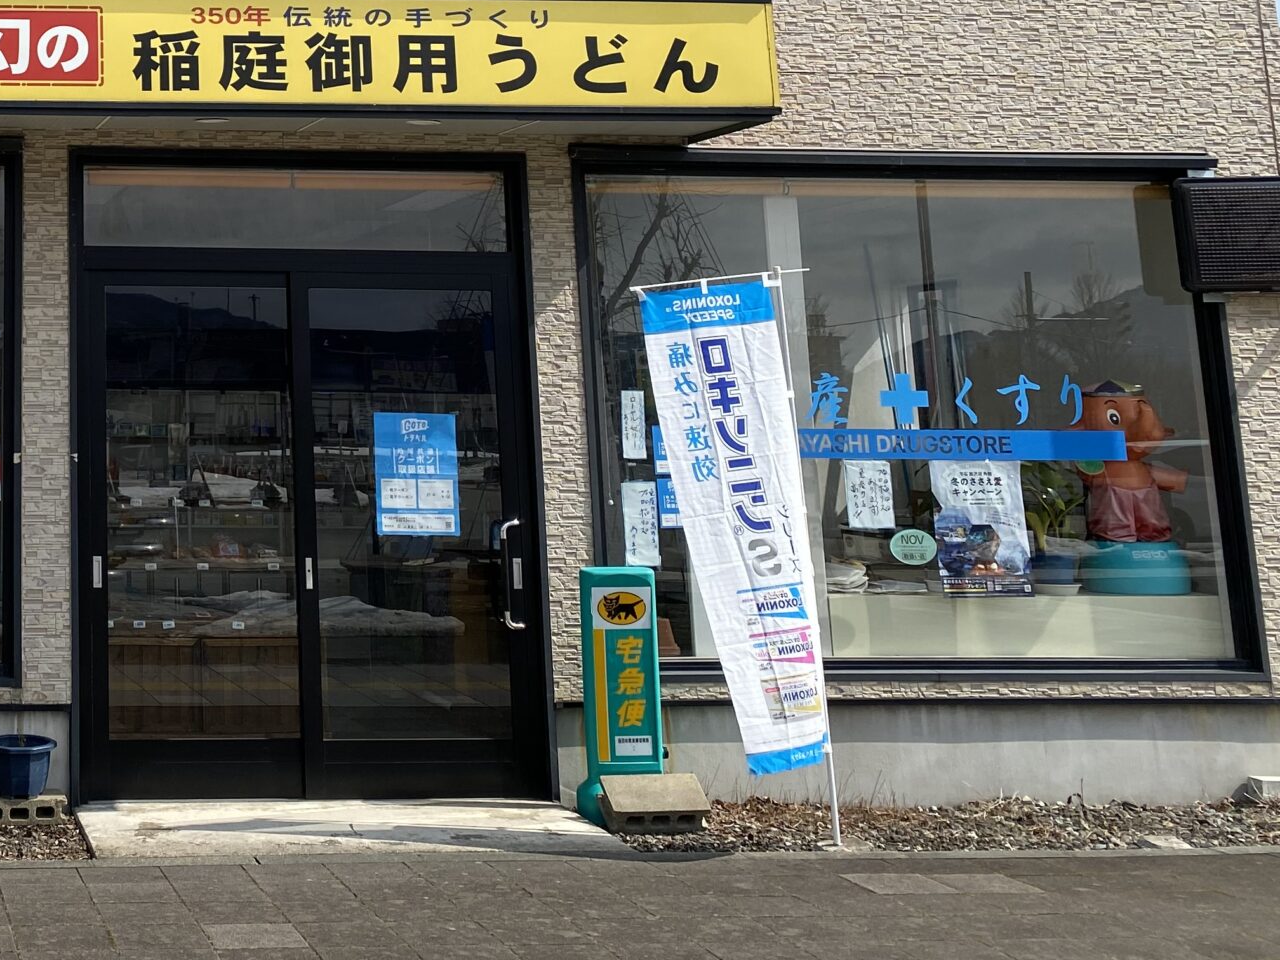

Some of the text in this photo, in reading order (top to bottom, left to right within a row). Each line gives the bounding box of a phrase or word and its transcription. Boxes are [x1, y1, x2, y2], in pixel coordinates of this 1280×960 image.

[132, 30, 719, 95] 稲庭御用うどん
[955, 373, 1084, 425] くすり
[877, 435, 1013, 455] DRUGSTORE
[398, 455, 435, 464] クーポン
[951, 477, 1003, 487] 冬のささえ愛
[952, 488, 1002, 497] キャンペーン
[900, 534, 925, 545] NOV
[615, 635, 646, 727] 宅急便
